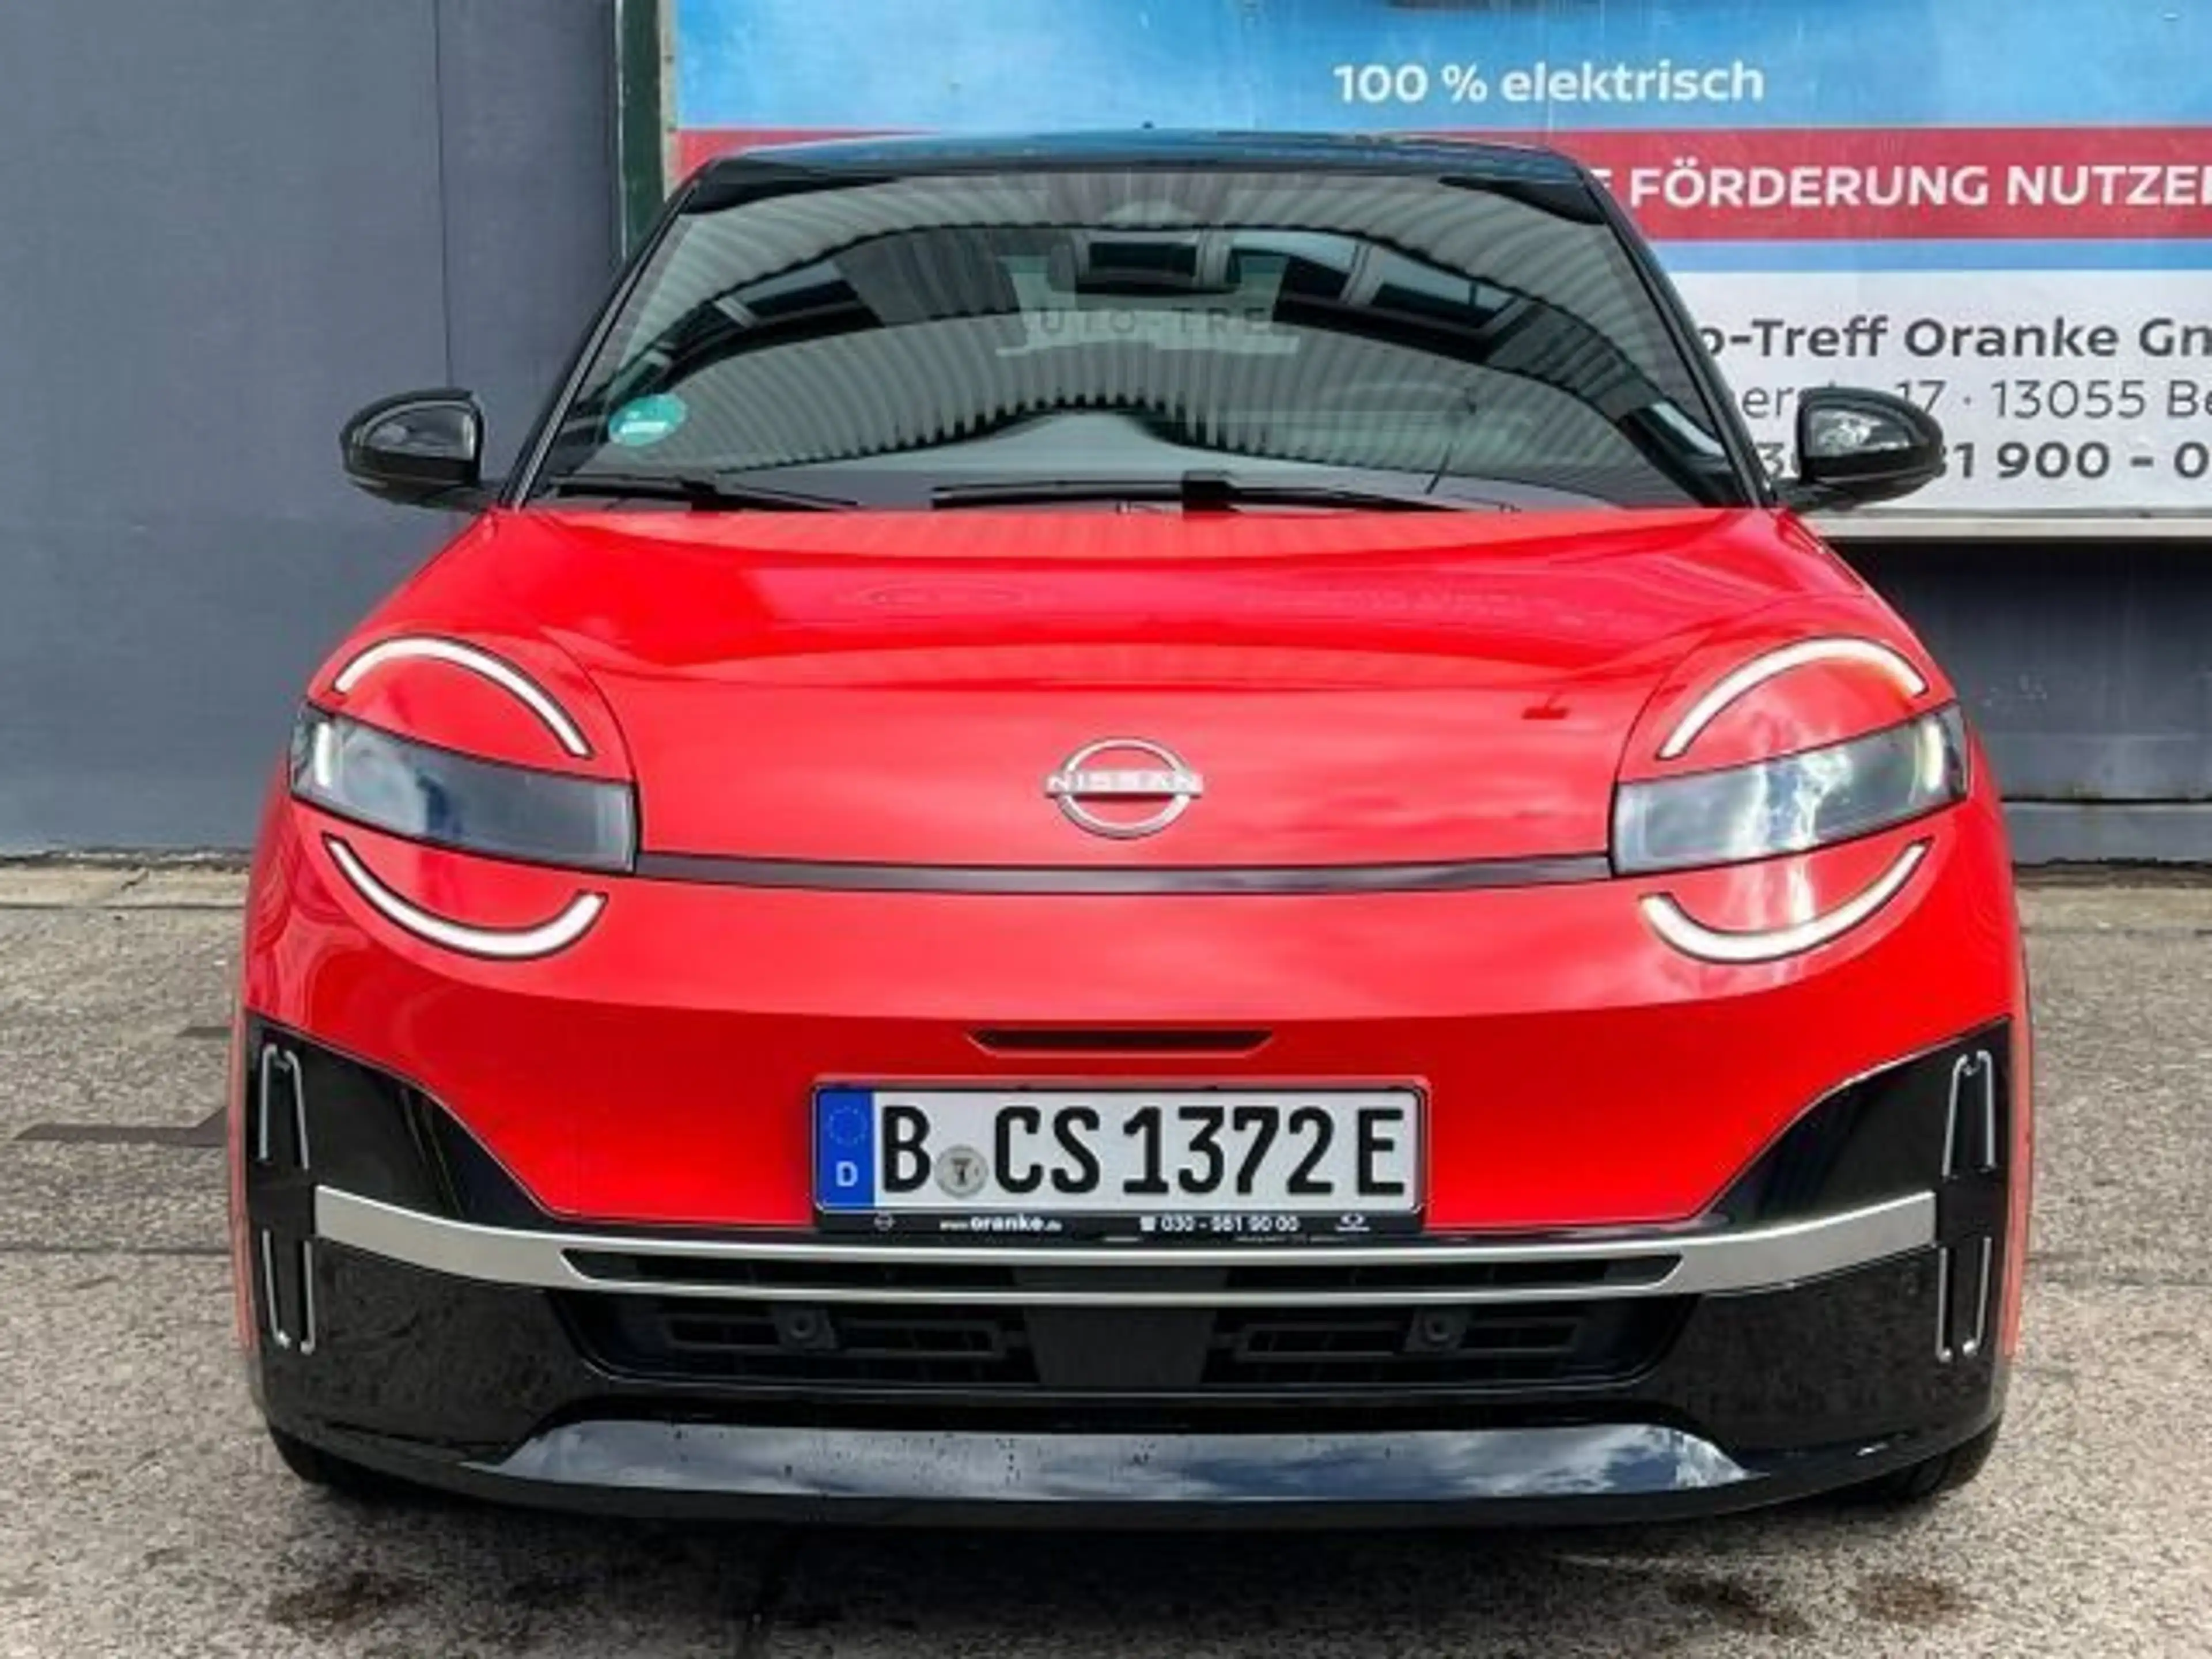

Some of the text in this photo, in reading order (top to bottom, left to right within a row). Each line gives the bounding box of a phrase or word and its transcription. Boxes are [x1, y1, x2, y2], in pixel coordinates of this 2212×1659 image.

[1334, 60, 1764, 103] 100 % elektrisch
[1630, 156, 1989, 207] FÖRDERUNG
[1904, 315, 2119, 357] Oranke
[1991, 379, 2146, 419] 13055
[2168, 379, 2212, 418] B
[1997, 441, 2110, 479] 900
[2173, 441, 2210, 479] 0
[882, 1105, 931, 1193] B
[995, 1106, 1101, 1194] CS
[836, 1161, 859, 1187] D
